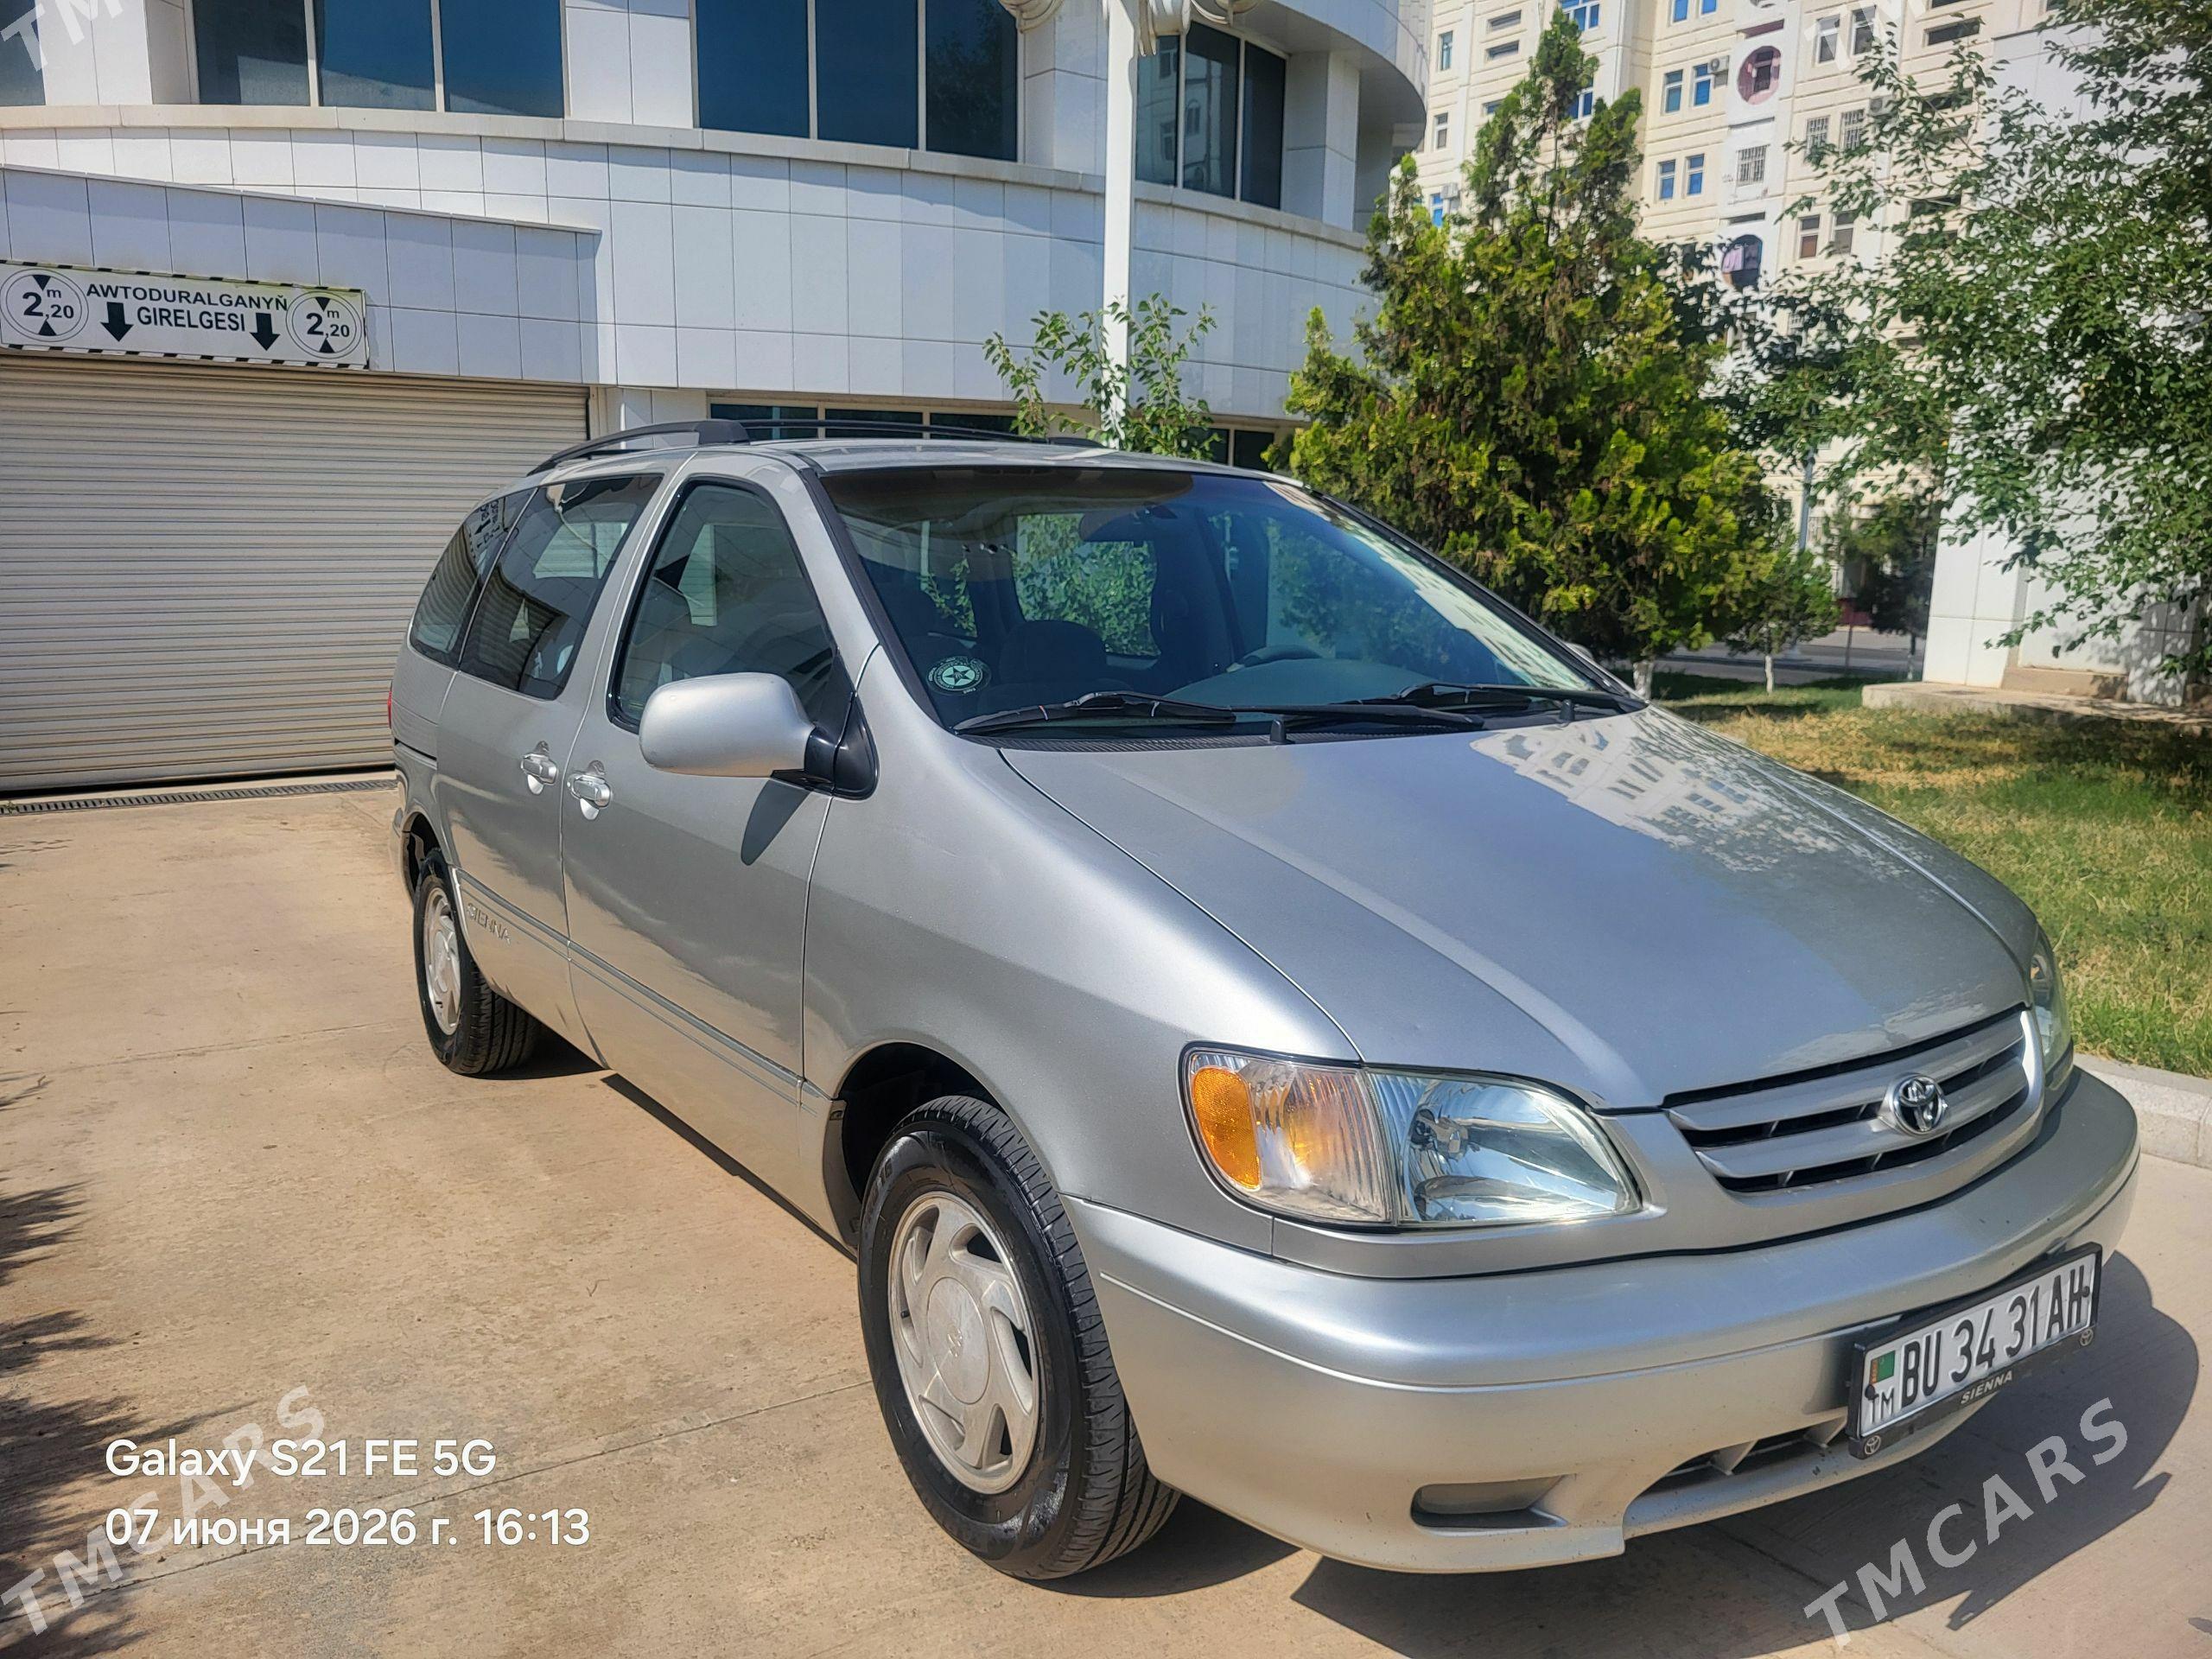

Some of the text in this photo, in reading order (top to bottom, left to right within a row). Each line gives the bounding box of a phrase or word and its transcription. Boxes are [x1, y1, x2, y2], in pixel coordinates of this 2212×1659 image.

[86, 283, 288, 311] AWTODURALGANYŇ
[137, 307, 245, 332] GIRELGESI
[1902, 1265, 2086, 1408] BU 34 31 AH
[1960, 1370, 2012, 1404] SIENNA
